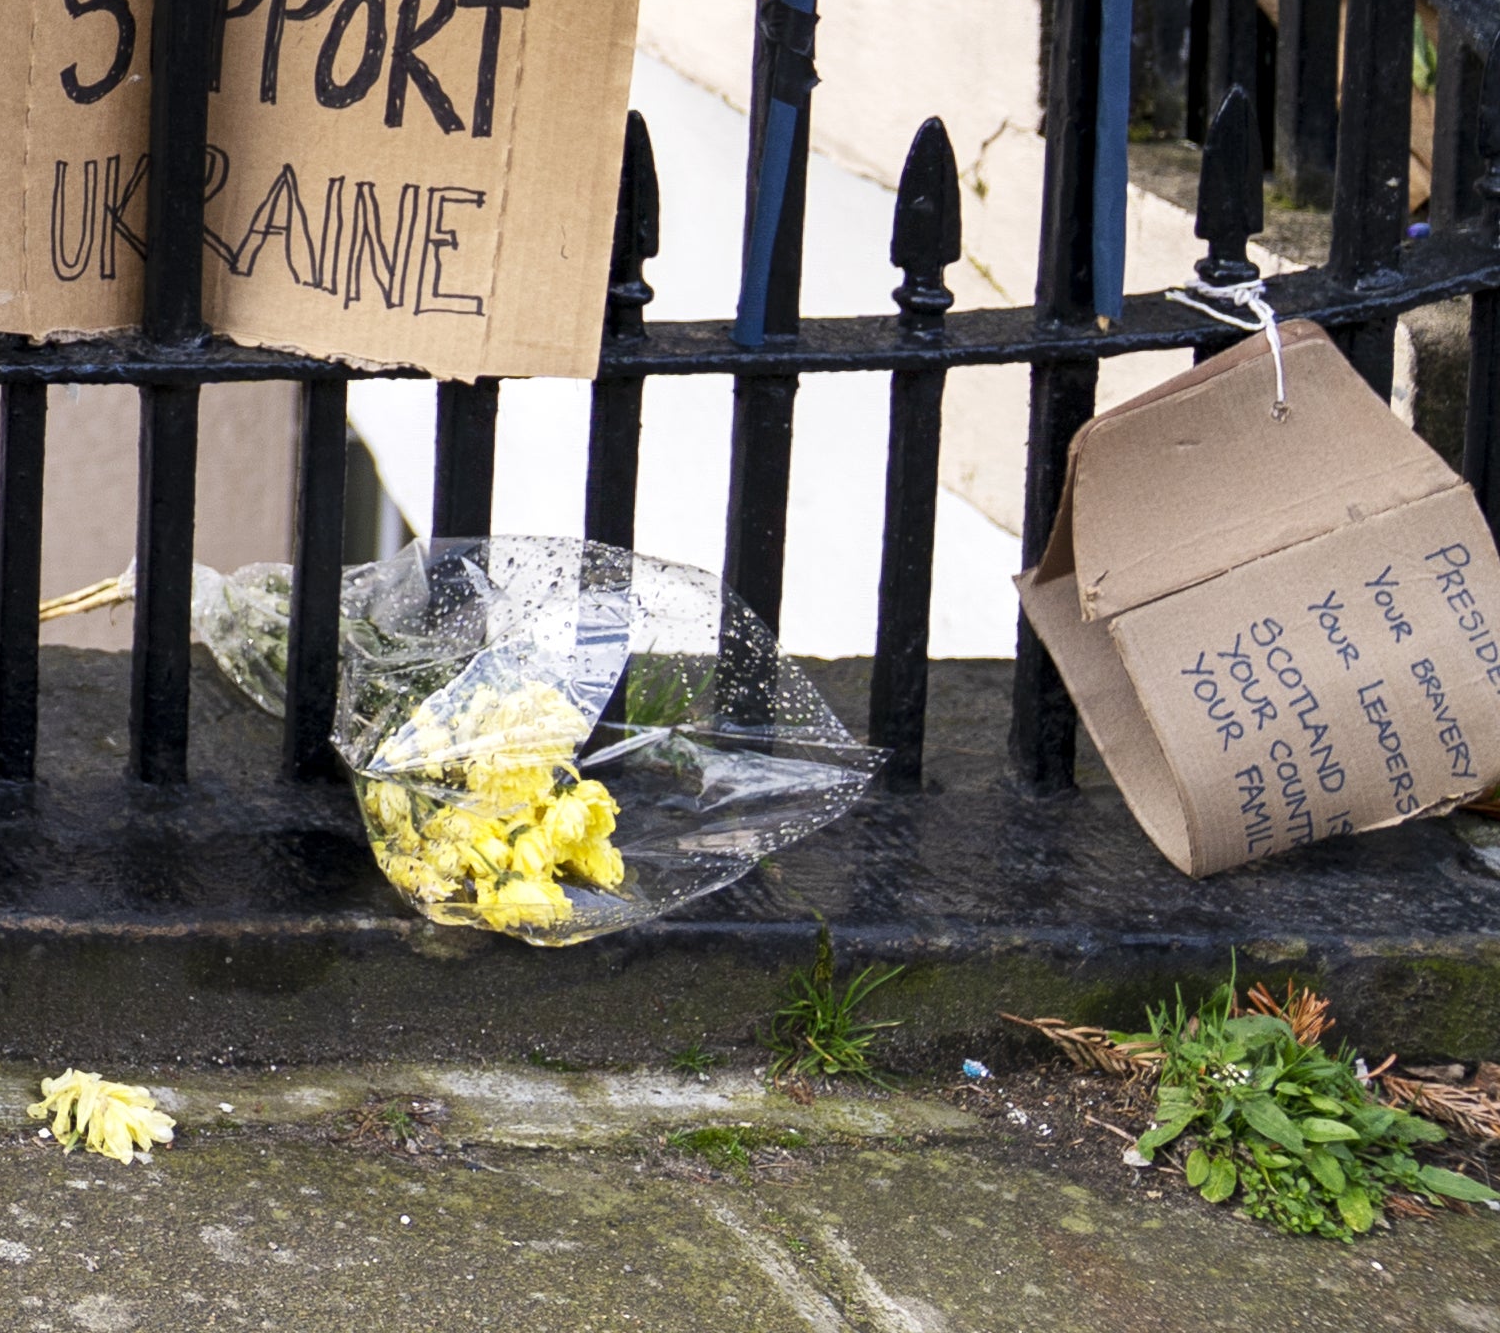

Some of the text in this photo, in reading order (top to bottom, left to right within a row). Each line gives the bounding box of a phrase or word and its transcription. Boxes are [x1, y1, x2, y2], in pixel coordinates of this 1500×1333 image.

[1217, 633, 1278, 731] YOUR
[1250, 617, 1346, 794] SCOTLAND
[1307, 590, 1422, 816] YOUR LEADERS
[1365, 565, 1478, 779] YOUR BRAVERY
[1425, 542, 1500, 695] PRESIDE
[1181, 651, 1274, 858] YOUR FAMIL
